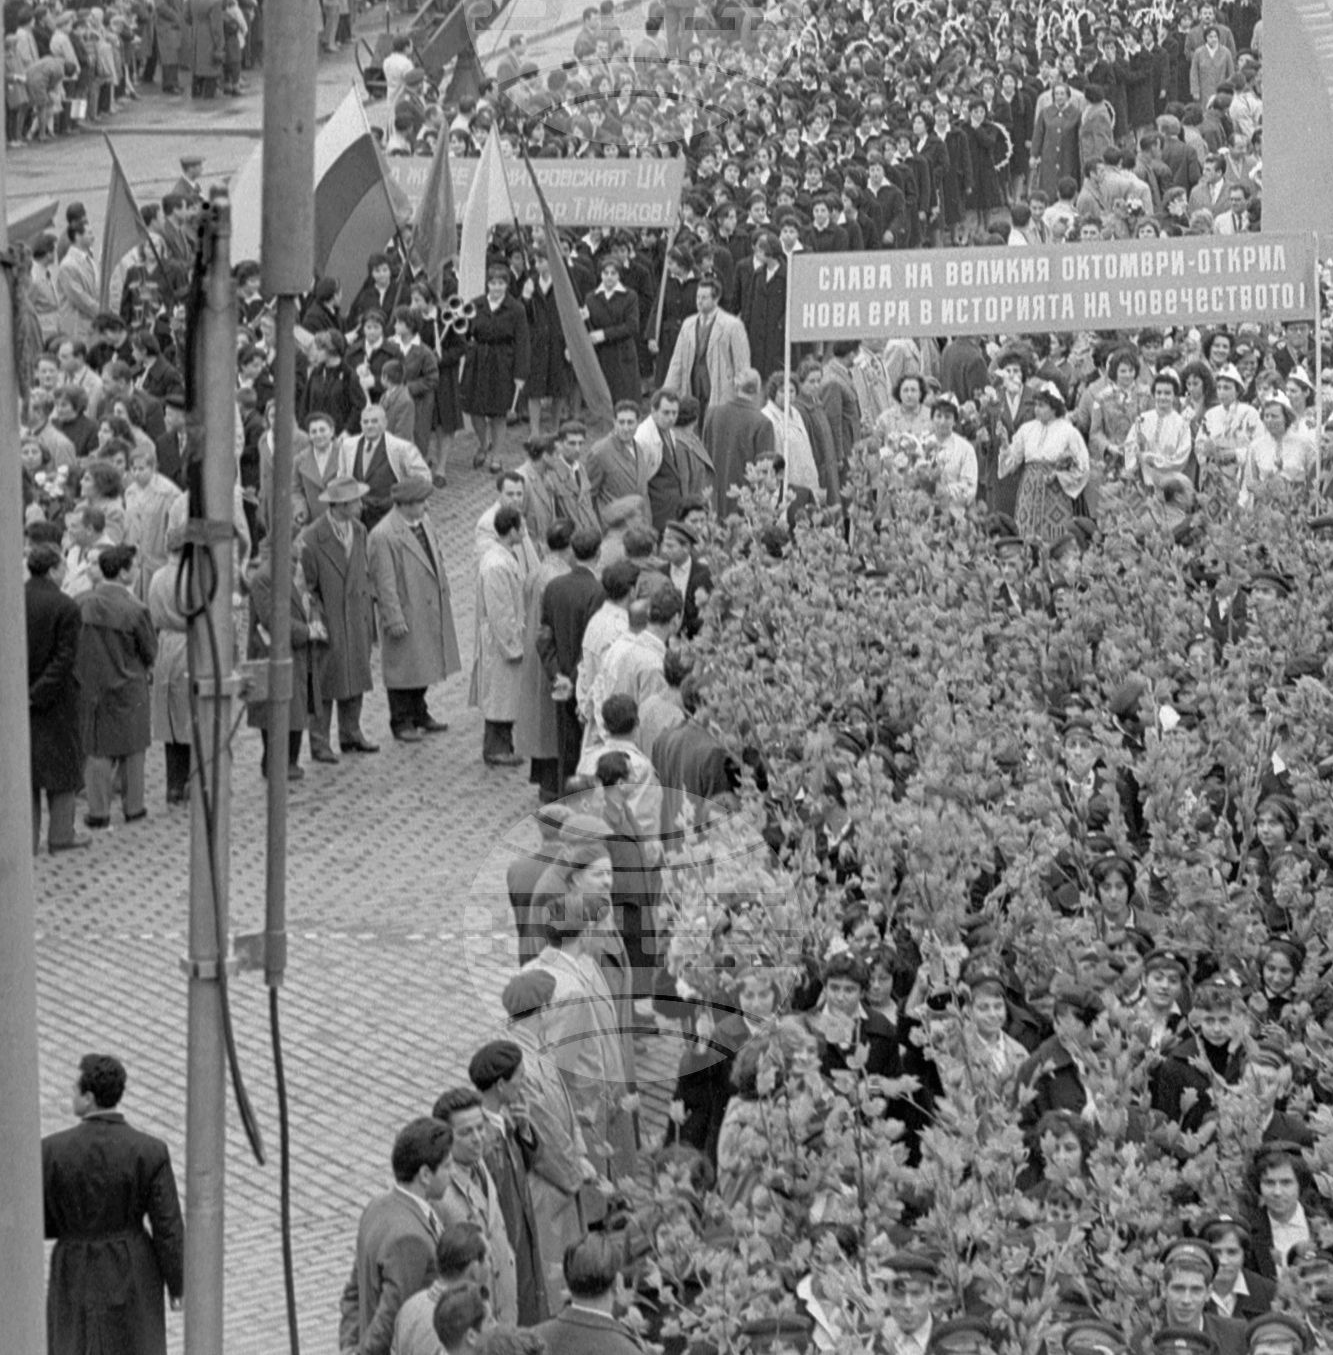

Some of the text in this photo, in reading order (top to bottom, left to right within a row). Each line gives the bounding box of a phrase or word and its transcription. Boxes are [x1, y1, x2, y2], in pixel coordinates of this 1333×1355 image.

[637, 163, 668, 189] ЦК
[818, 263, 892, 291] СЛАВА
[905, 262, 933, 288] НА
[803, 301, 861, 328] НОВА
[920, 298, 933, 325] В
[941, 292, 1075, 325] ИСТОРИЯТА
[1084, 291, 1112, 318] НА
